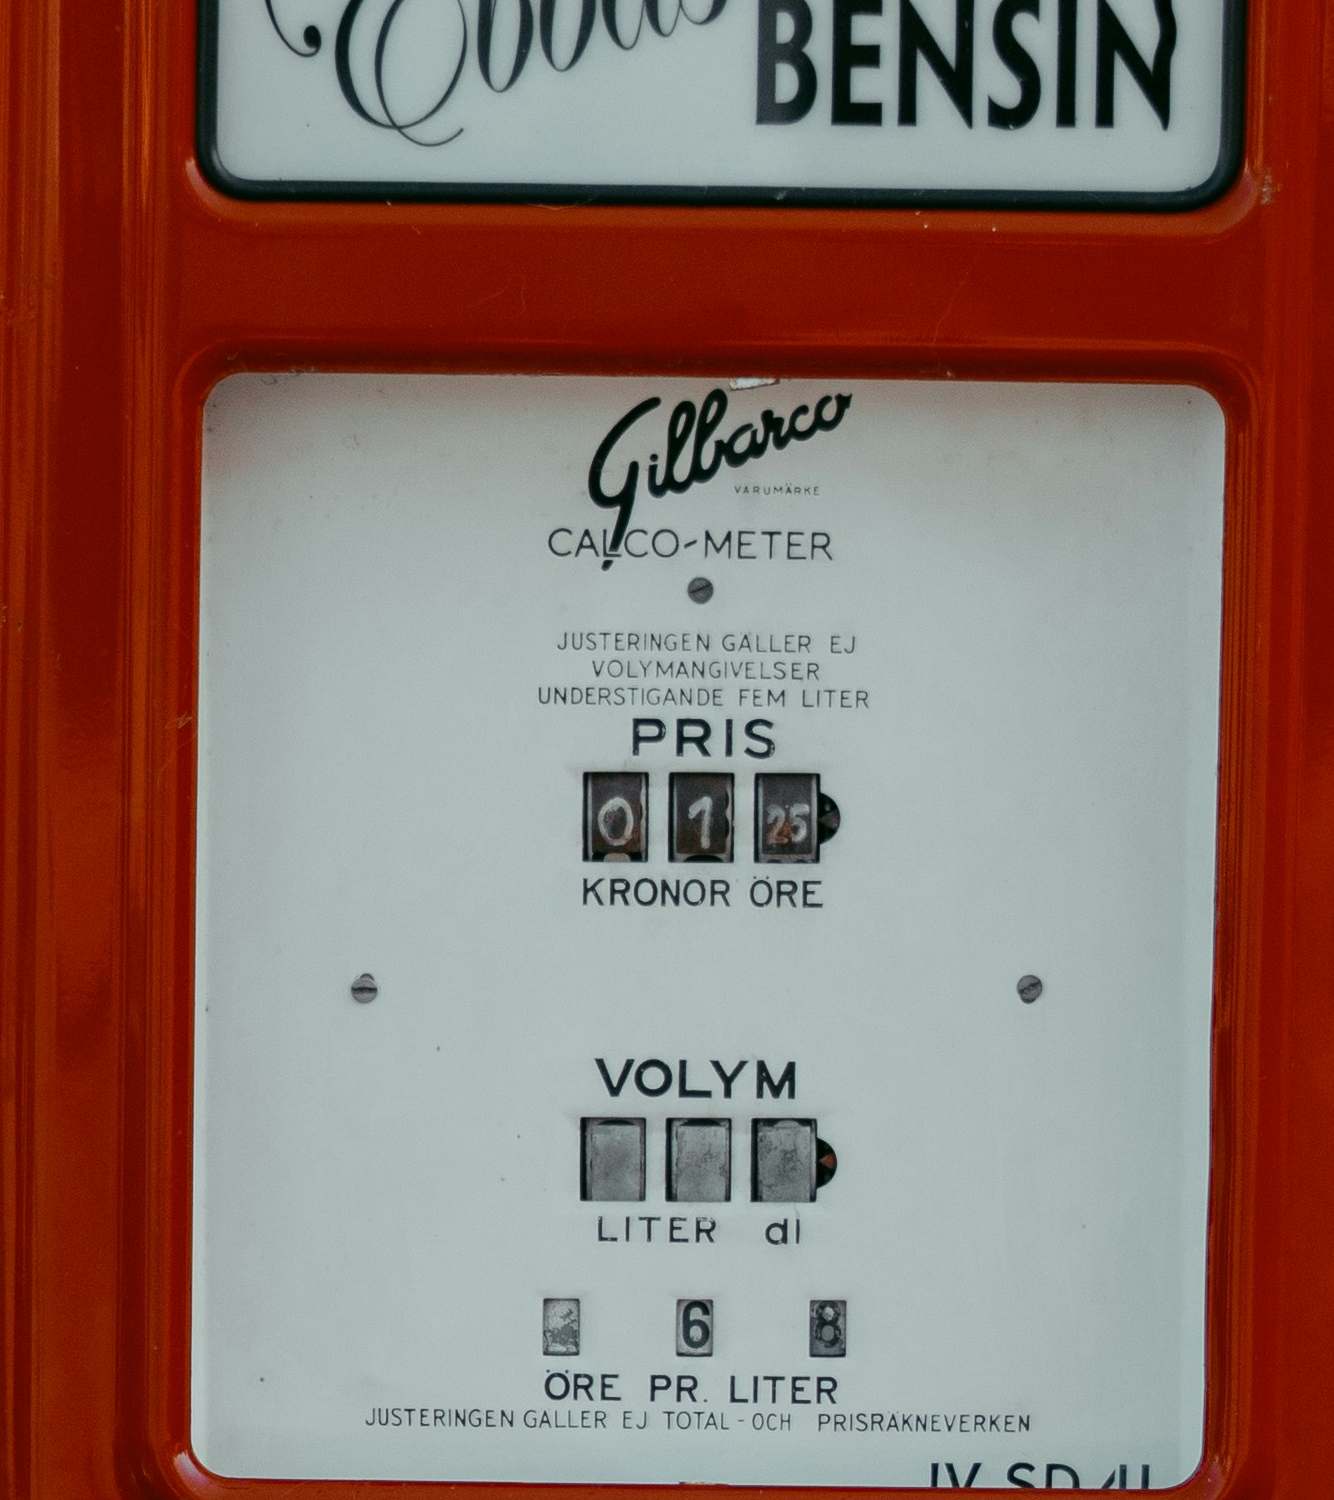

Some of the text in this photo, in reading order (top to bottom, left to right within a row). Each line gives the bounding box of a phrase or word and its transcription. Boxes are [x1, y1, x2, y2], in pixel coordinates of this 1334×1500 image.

[587, 388, 854, 572] Gilbarco
[556, 631, 711, 653] JUSTERINGEN
[830, 635, 856, 655] EJ
[591, 659, 820, 681] VOLYMANGIVELSER
[538, 686, 869, 709] UNDERSTIGANDE FEM LITER
[631, 717, 776, 760] PRIS
[597, 796, 811, 849] 0 1 25
[582, 875, 824, 909] KRONOR ÖRE
[594, 1057, 797, 1100] VOLYM
[597, 1215, 717, 1244] LITER
[682, 1301, 710, 1349] 6
[544, 1369, 838, 1405] ÖRE PR. LITER
[365, 1407, 515, 1428] JUSTERINGEN
[622, 1410, 648, 1430] EJ
[751, 1412, 791, 1432] OCH
[817, 1410, 1031, 1433] PRISRÄKNEVERKEN
